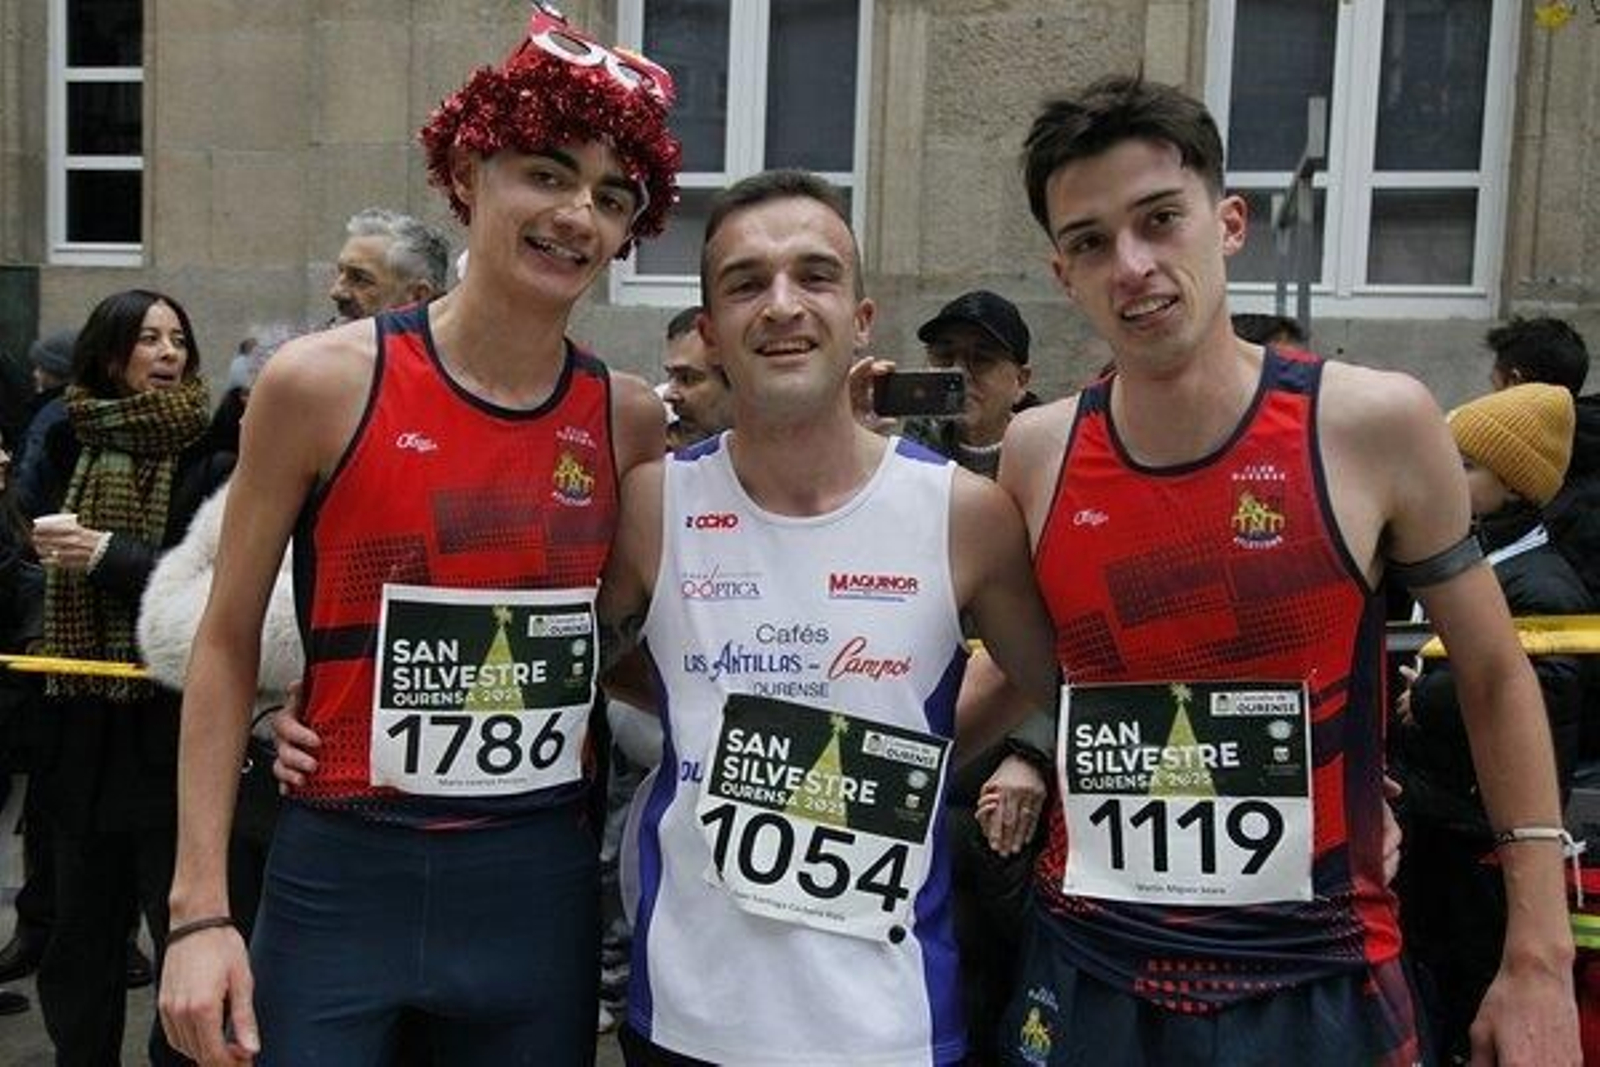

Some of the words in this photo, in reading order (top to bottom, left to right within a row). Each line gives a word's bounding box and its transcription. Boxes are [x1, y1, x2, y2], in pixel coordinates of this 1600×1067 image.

[695, 513, 738, 529] OCHO
[831, 573, 918, 592] MAQUINOR
[756, 622, 829, 645] Cafés
[392, 639, 459, 664] SAN
[392, 660, 547, 691] SILVESTRE
[754, 681, 829, 698] OURENSE
[386, 711, 566, 776] 1786
[726, 729, 791, 762] SAN
[1075, 721, 1141, 748] SAN
[1075, 742, 1241, 775] SILVESTRE
[722, 756, 879, 805] SILVESTRE
[1089, 799, 1285, 875] 1119
[700, 803, 910, 913] 1054
